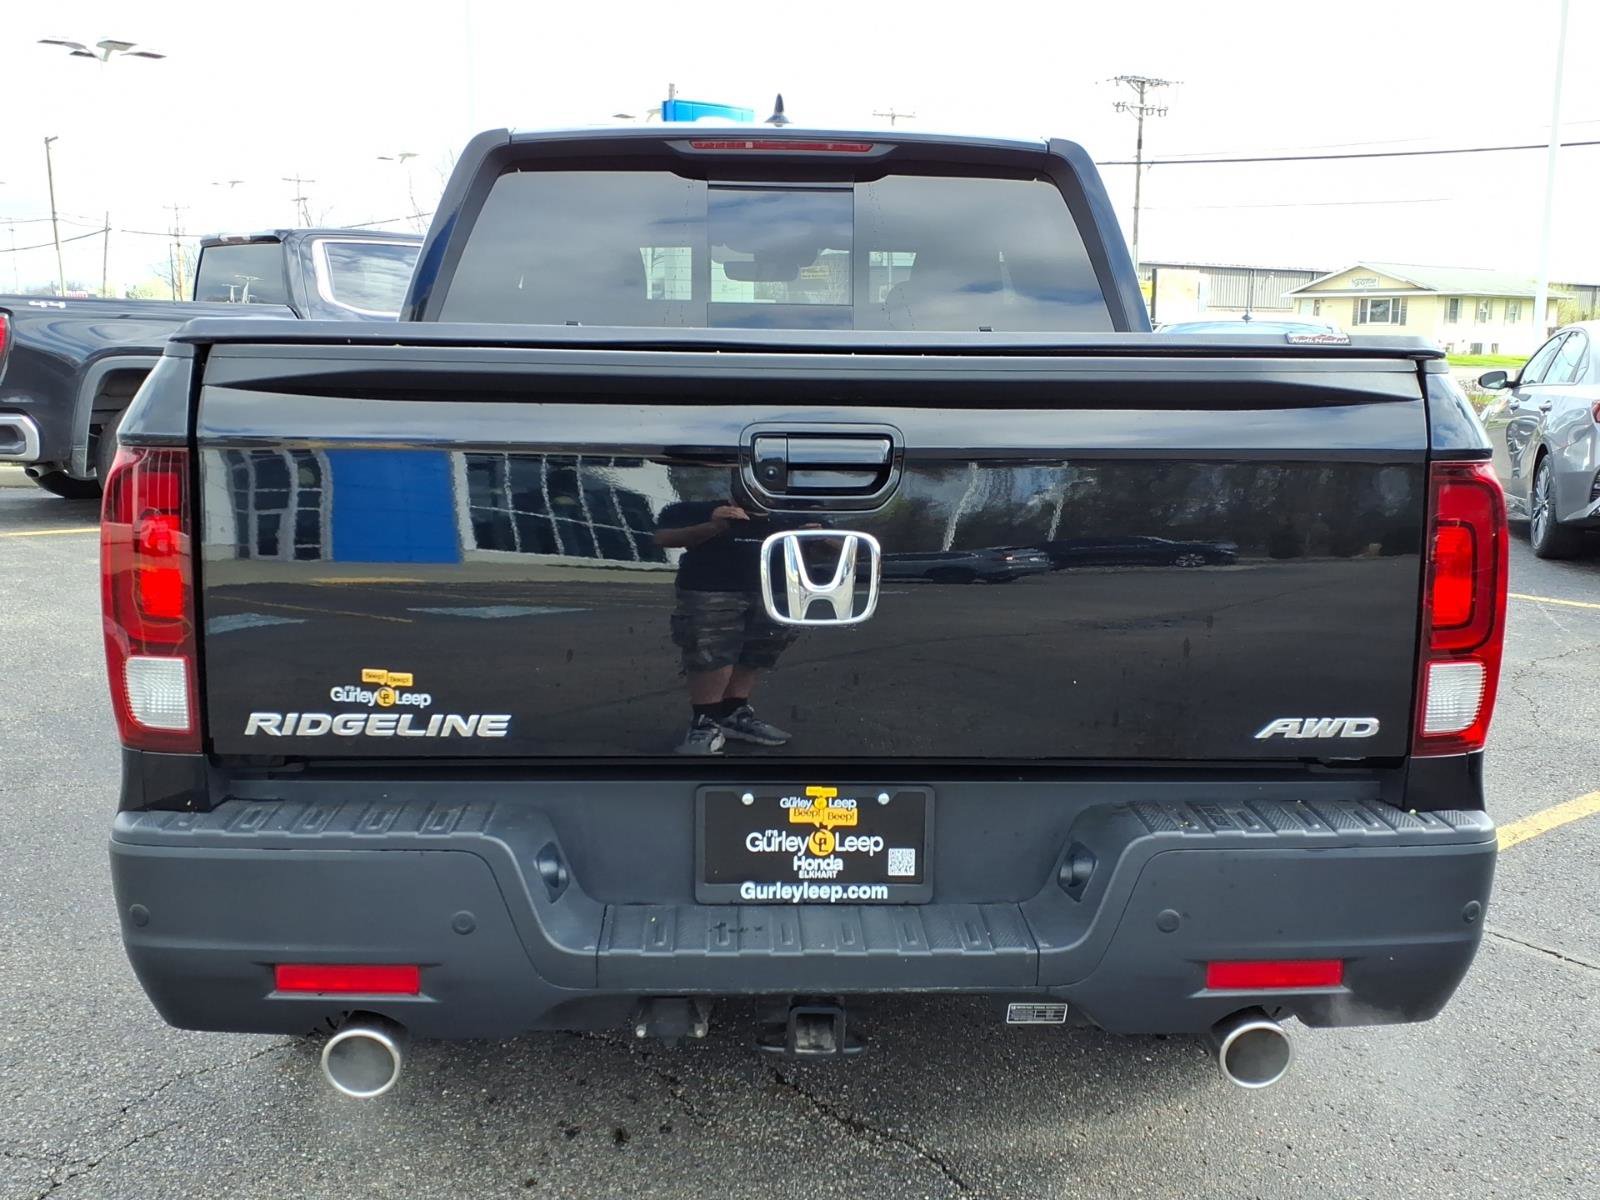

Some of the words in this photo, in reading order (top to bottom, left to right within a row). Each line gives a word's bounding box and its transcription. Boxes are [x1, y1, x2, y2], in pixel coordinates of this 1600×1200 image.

[395, 690, 431, 708] Leep
[244, 712, 511, 737] RIDGELINE
[1254, 717, 1380, 738] AWD
[828, 797, 857, 811] Leep
[827, 812, 855, 822] Beep!
[835, 832, 884, 857] Leep
[793, 854, 843, 871] Honda
[798, 870, 838, 879] ELKHART
[740, 881, 889, 903] Gurleyleep.com
